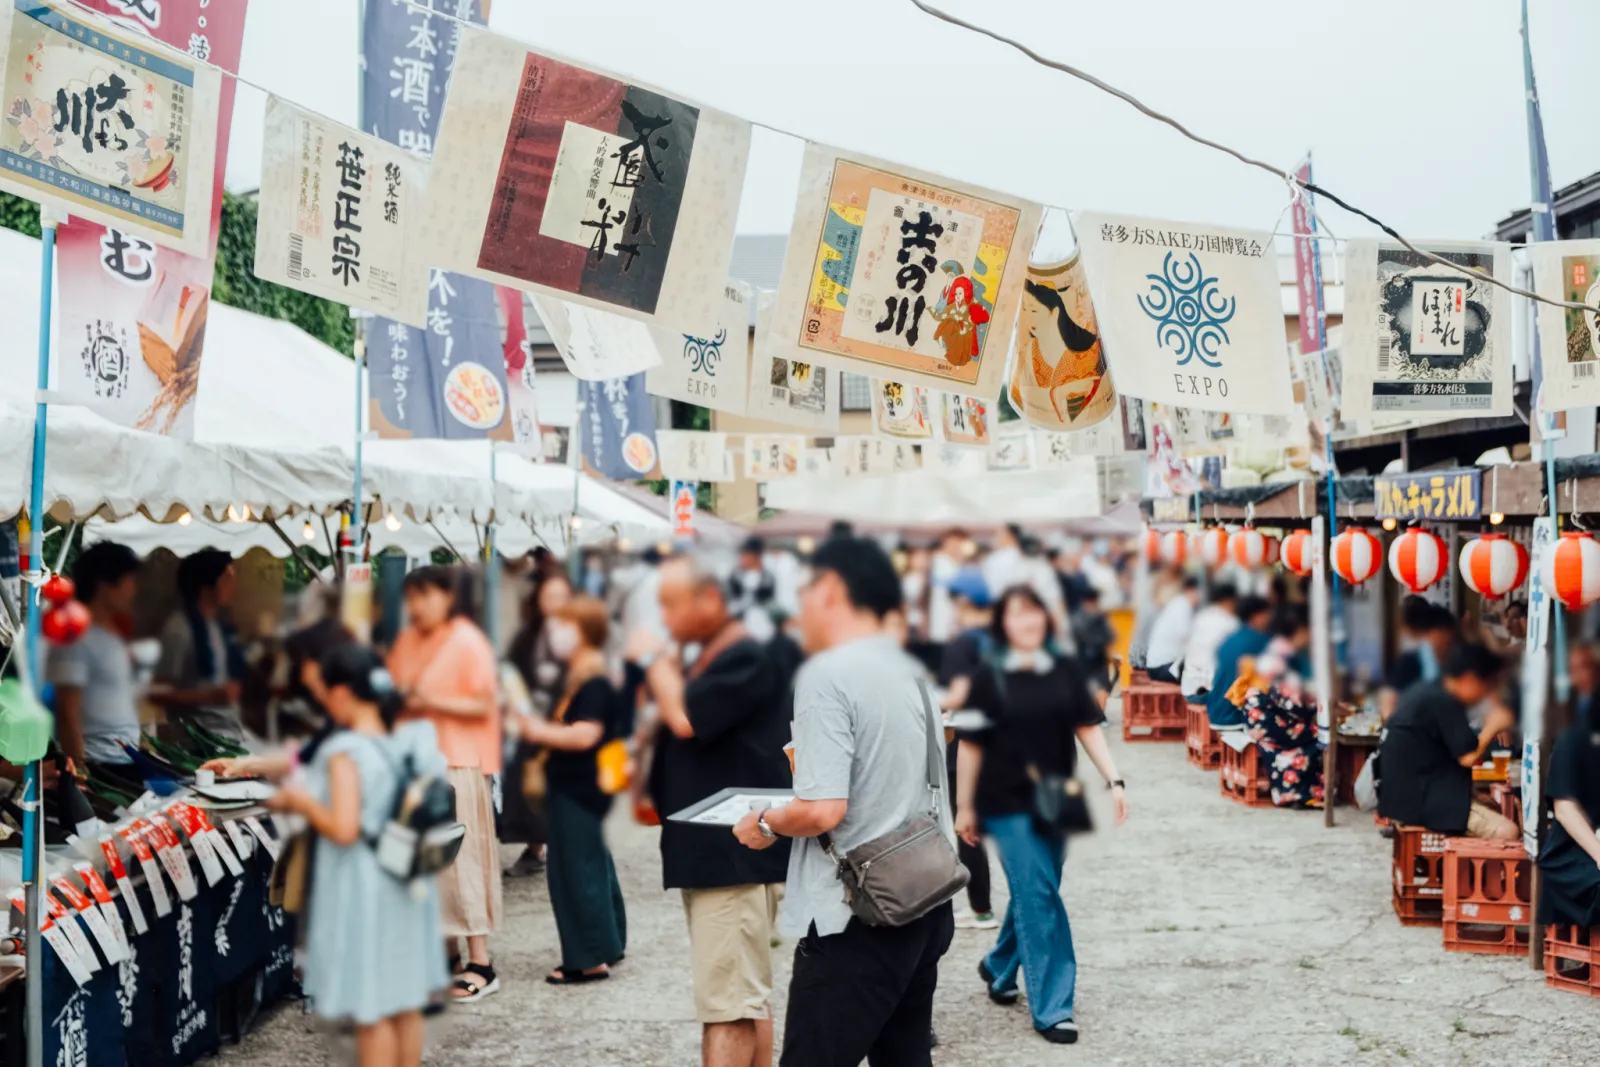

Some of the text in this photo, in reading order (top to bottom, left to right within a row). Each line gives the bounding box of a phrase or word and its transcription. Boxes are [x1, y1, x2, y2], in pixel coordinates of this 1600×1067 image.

[525, 64, 539, 89] 清酒
[384, 162, 401, 225] 純米酒
[586, 135, 609, 200] 大吟醸交響曲
[331, 140, 366, 287] 笹正宗
[104, 228, 153, 281] む
[1100, 223, 1262, 258] 喜多方SAKE万国博覧会
[1422, 288, 1461, 348] ほまれ
[686, 376, 717, 399] EXPO
[1174, 373, 1229, 398] EXPO
